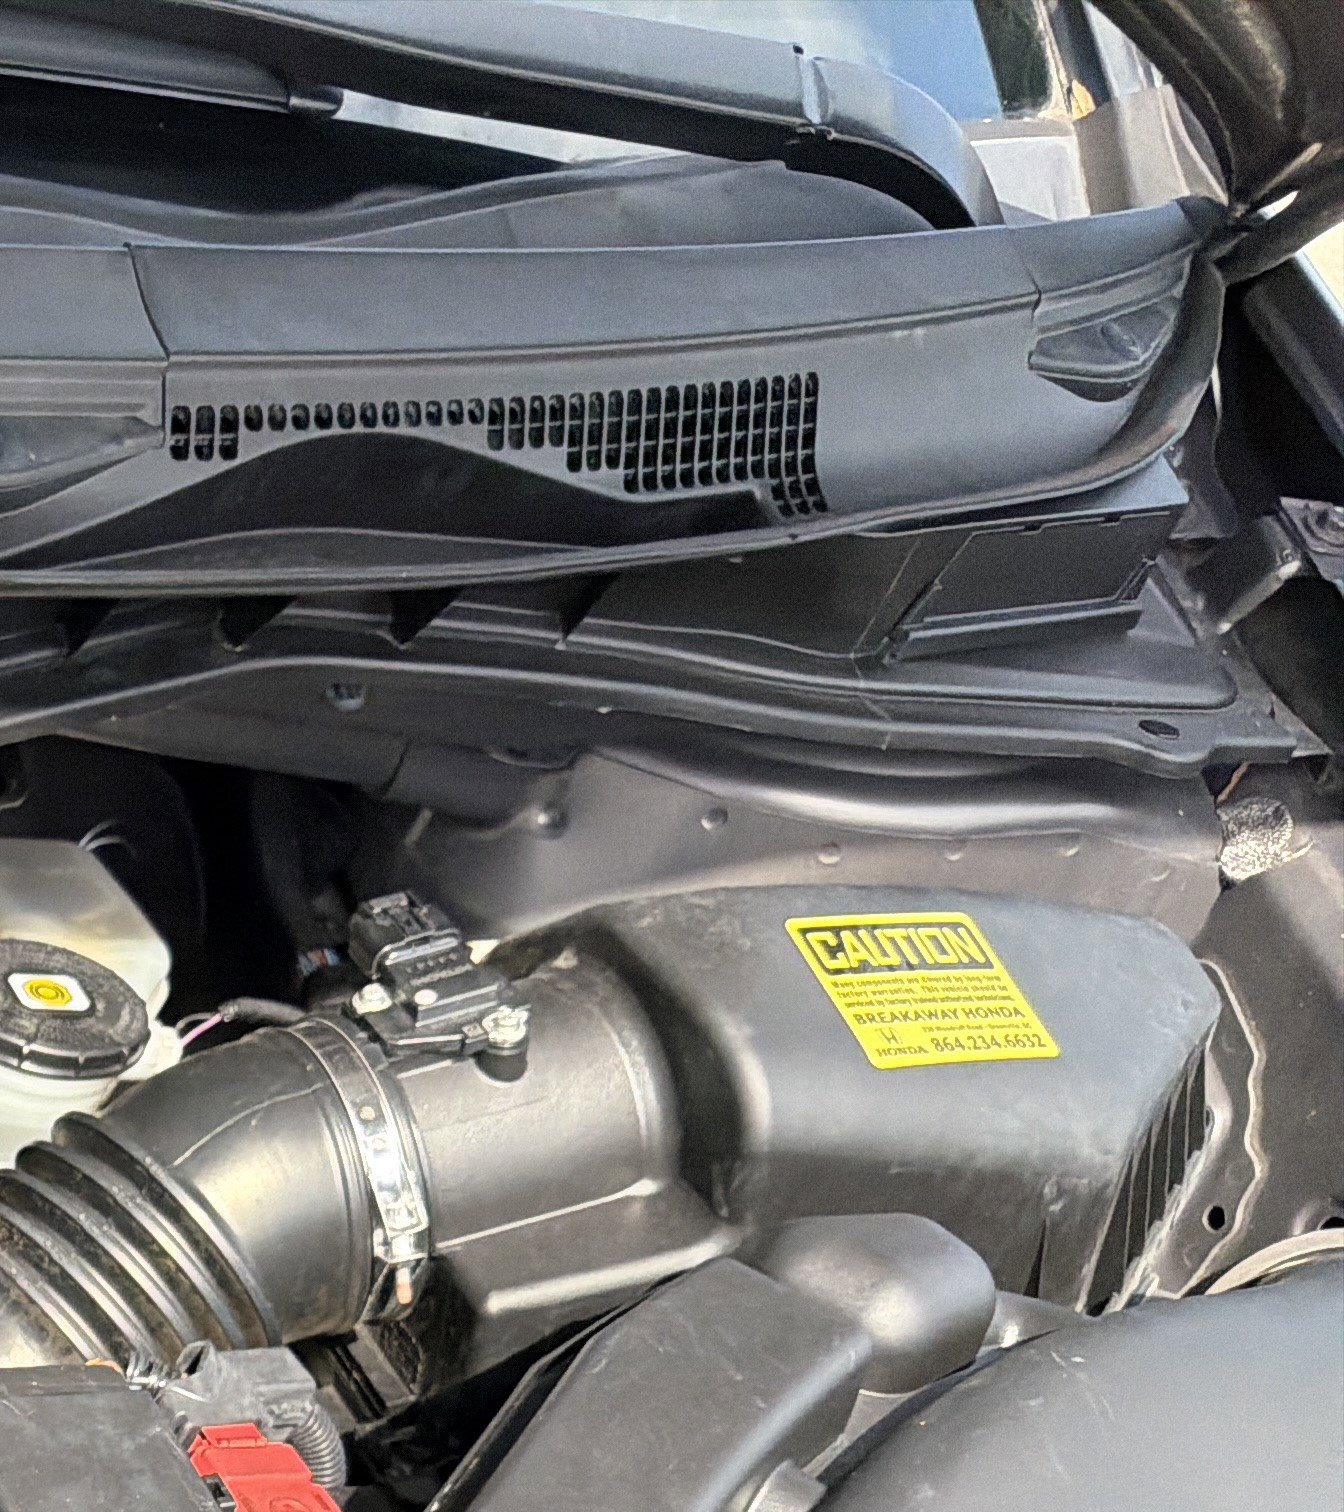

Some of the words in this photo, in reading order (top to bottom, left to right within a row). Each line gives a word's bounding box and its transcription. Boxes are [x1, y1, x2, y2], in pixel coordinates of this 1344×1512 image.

[806, 927, 986, 970] CAUTION
[853, 1008, 959, 1025] BREAKAWAY
[961, 1006, 1026, 1020] HONDA
[876, 1045, 929, 1058] HONDA
[930, 1033, 1047, 1052] 864.234.6632
